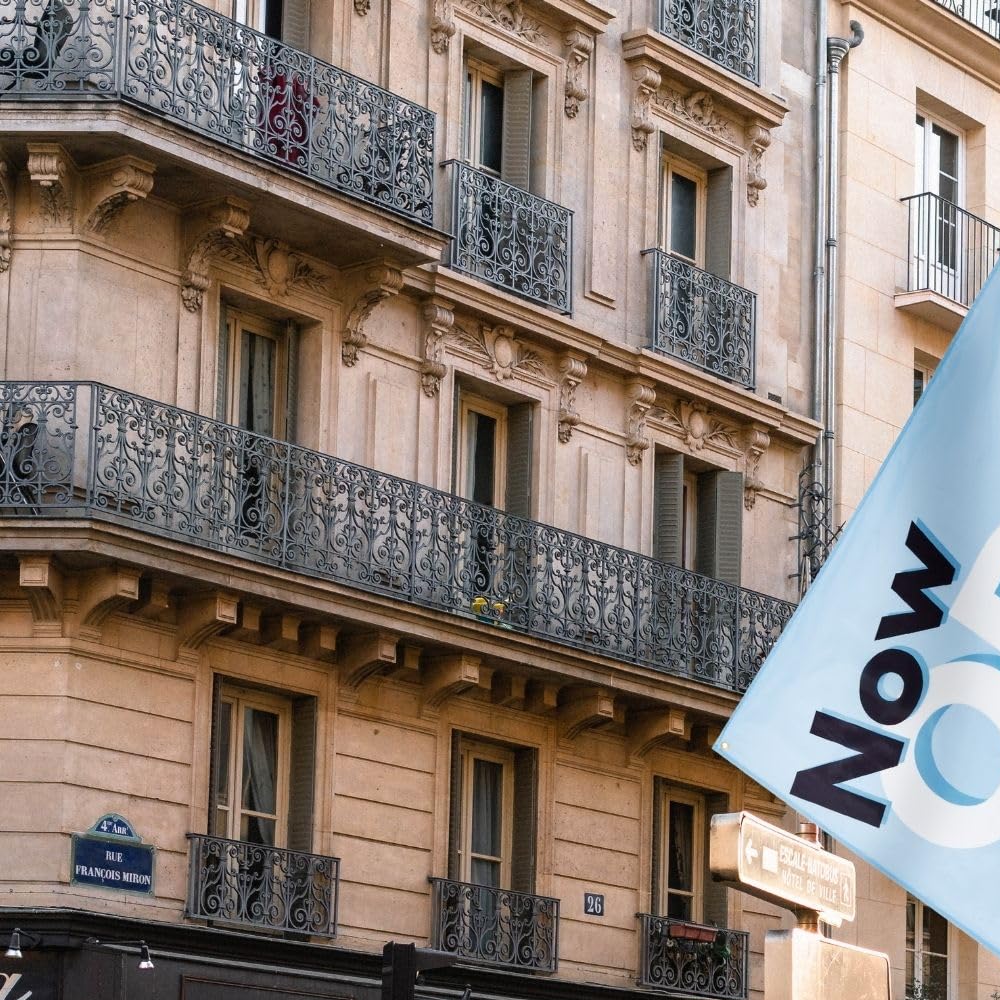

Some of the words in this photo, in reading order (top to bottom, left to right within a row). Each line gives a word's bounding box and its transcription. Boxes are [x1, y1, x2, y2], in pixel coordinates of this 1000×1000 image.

[105, 850, 123, 863] RUE
[75, 864, 121, 882] FRANÇOIS
[122, 871, 152, 885] MIRON
[818, 885, 837, 904] VILLE
[587, 895, 602, 914] 26
